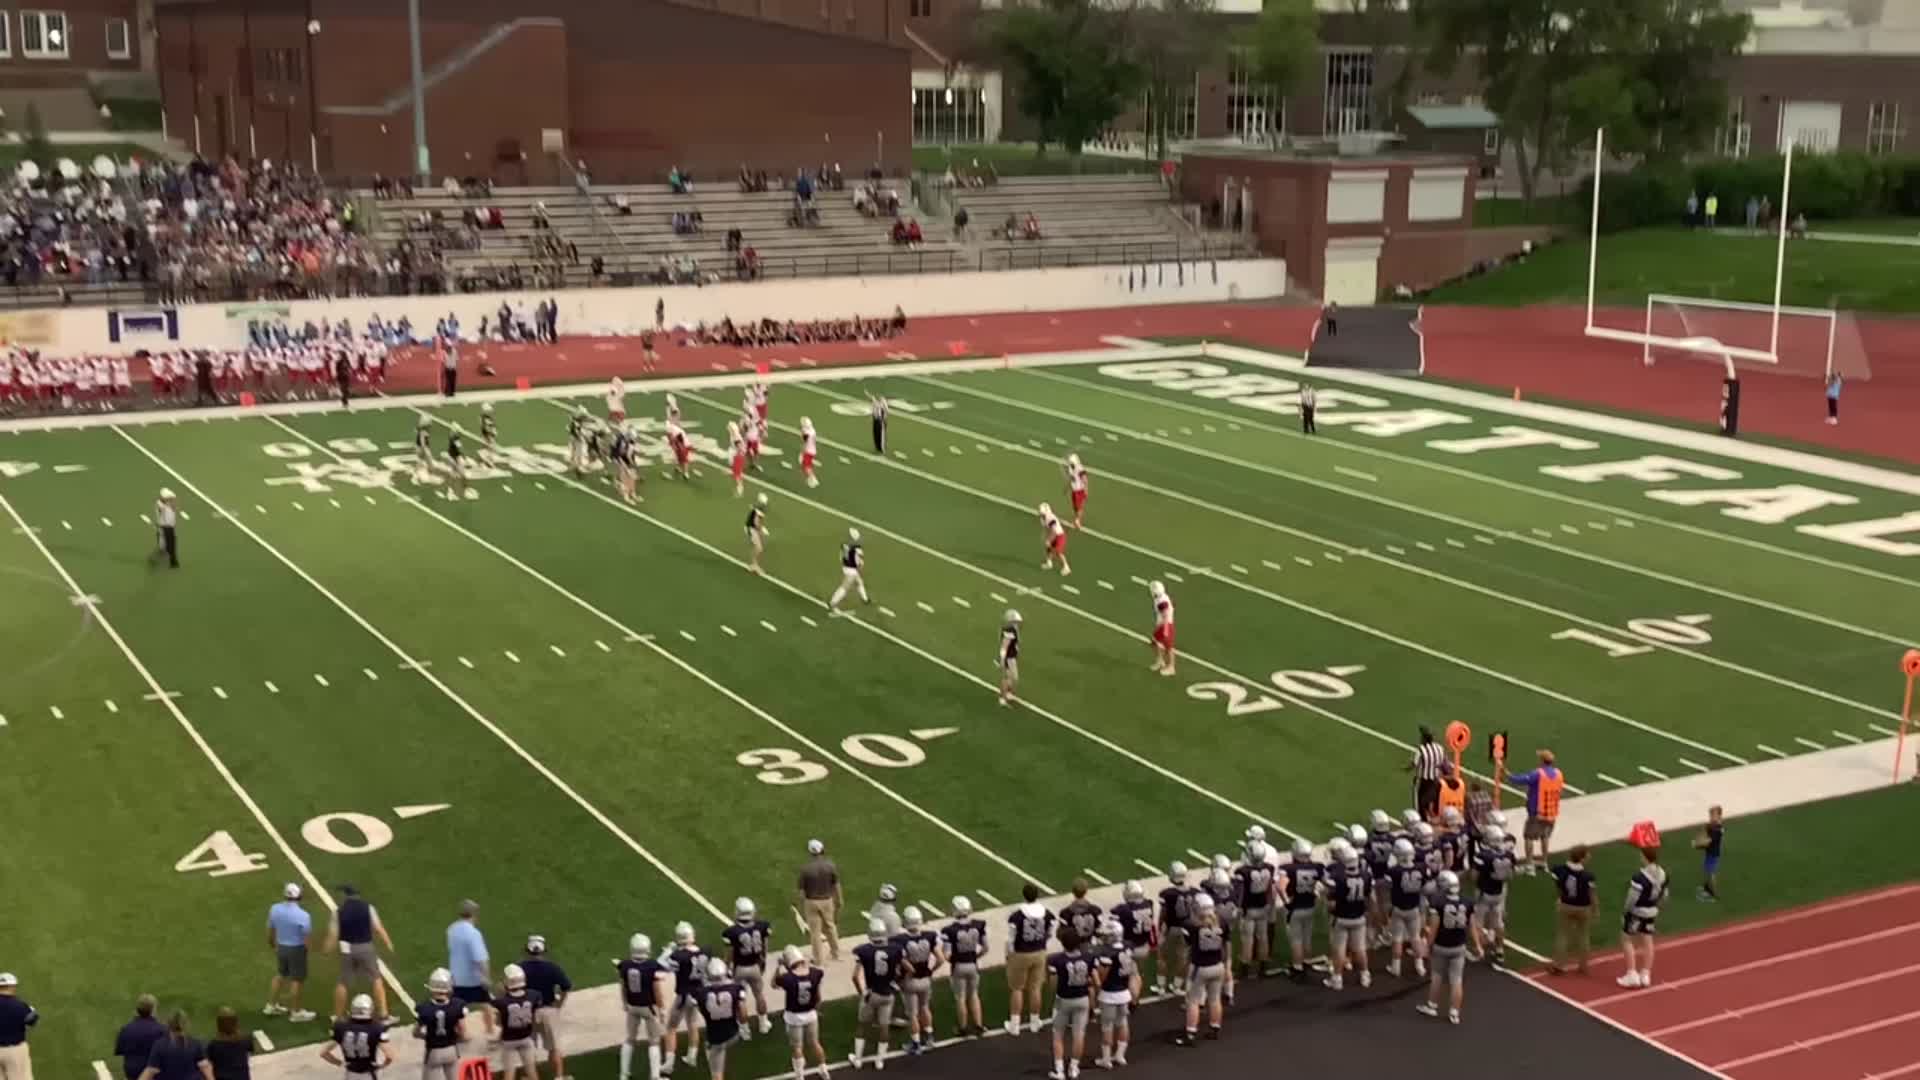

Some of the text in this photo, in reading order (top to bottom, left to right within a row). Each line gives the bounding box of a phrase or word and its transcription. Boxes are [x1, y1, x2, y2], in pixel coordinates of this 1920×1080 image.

[1098, 360, 1598, 453] GREAT
[1551, 618, 1712, 657] 10
[1186, 670, 1355, 716] 20
[736, 733, 926, 785] 30
[175, 812, 393, 877] 40
[874, 950, 889, 976] 6
[435, 1009, 448, 1037] 1
